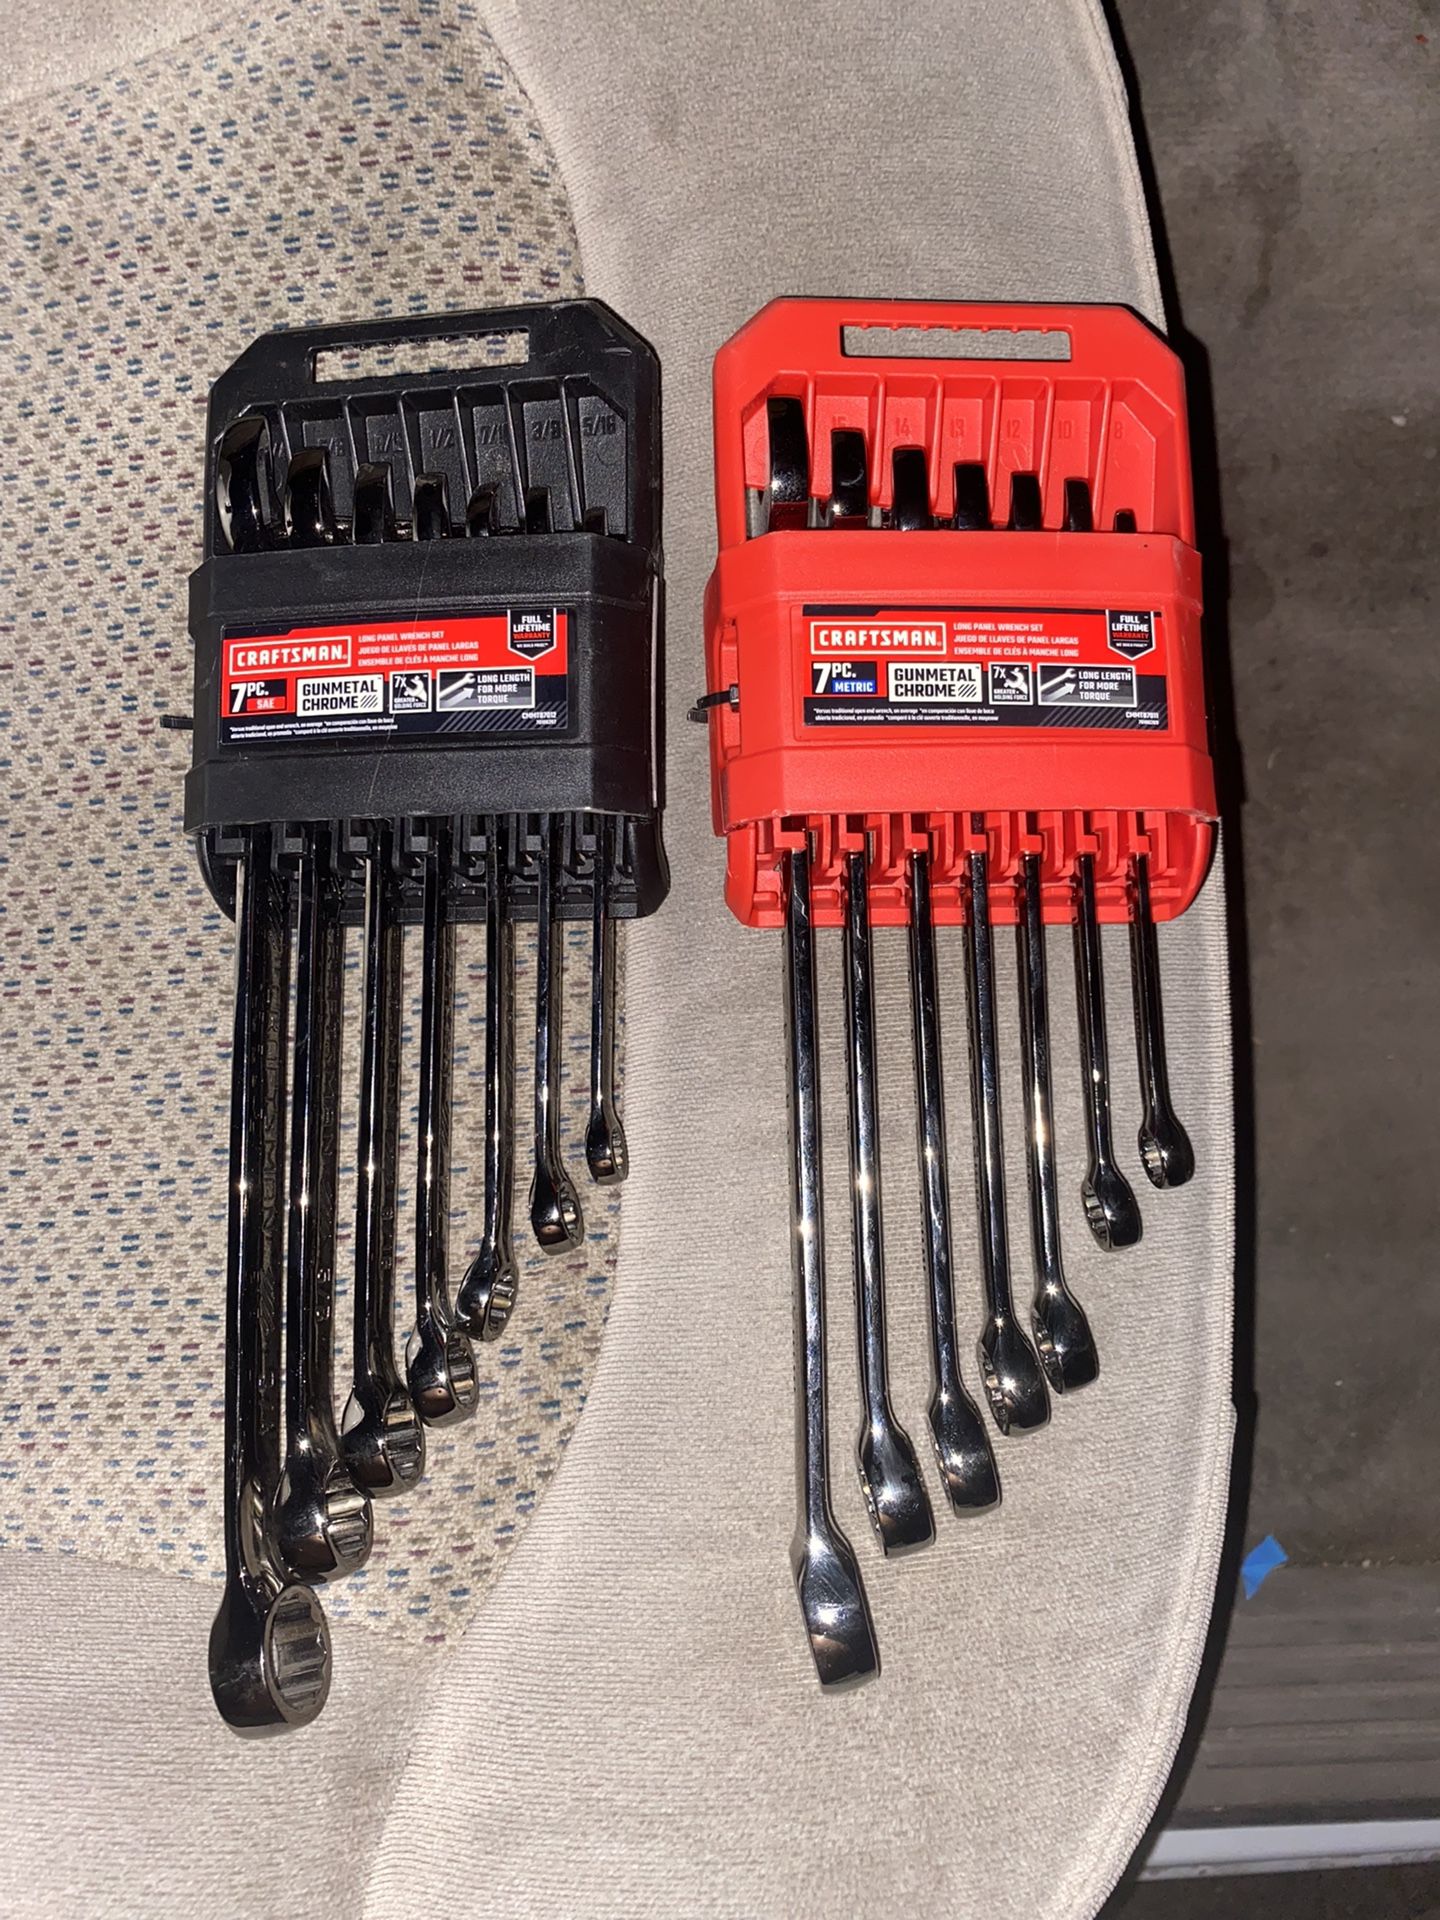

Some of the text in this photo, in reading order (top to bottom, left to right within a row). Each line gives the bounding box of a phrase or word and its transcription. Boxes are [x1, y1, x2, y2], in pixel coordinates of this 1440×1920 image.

[532, 417, 562, 441] 3/8
[581, 414, 616, 437] 5/16
[895, 417, 911, 437] 14
[1006, 419, 1021, 439] 12
[1058, 420, 1072, 439] 10
[1113, 421, 1124, 439] 8
[429, 427, 454, 449] 1/2
[521, 615, 542, 624] FULL
[1119, 615, 1140, 624] FULL
[513, 623, 551, 632] LIFETIME
[953, 622, 1043, 632] LONG PANEL WRENCH SET
[1111, 623, 1149, 632] LIFETIME
[358, 630, 444, 643] LONG PANEL WRENCH SET
[819, 629, 937, 647] CRAFTSMAN
[953, 634, 1079, 645] JUEGO DE LLAVES DE PANEL LARGAS
[358, 646, 380, 655] JUEGO
[381, 645, 390, 653] DE
[391, 644, 417, 653] LLAVES
[428, 643, 450, 651] PANEL
[451, 641, 479, 650] LARGAS
[953, 647, 991, 656] ENSEMBLE
[993, 647, 1002, 656] DE
[1029, 648, 1059, 657] MANCHE
[1061, 649, 1079, 657] LONG
[237, 644, 343, 667] CRAFTSMAN
[358, 657, 393, 667] ENSEMBLE
[429, 655, 459, 663] MANCHE
[460, 653, 479, 662] LONG
[477, 673, 530, 683] LONG LENGTH
[894, 667, 976, 683] GUNMETAL
[993, 666, 1006, 679] 7X
[1078, 671, 1131, 681] LONG LENGTH
[394, 675, 407, 688] 7X
[834, 681, 873, 693] METRIC
[1079, 681, 1119, 691] FOR MORE
[302, 680, 378, 698] GUNMETAL
[477, 683, 518, 694] FOR MORE
[894, 683, 957, 699] CHROME
[477, 694, 508, 704] TORQUE
[1079, 691, 1111, 701] TORQUE
[256, 698, 275, 710] SAE
[302, 697, 359, 715] CHROME
